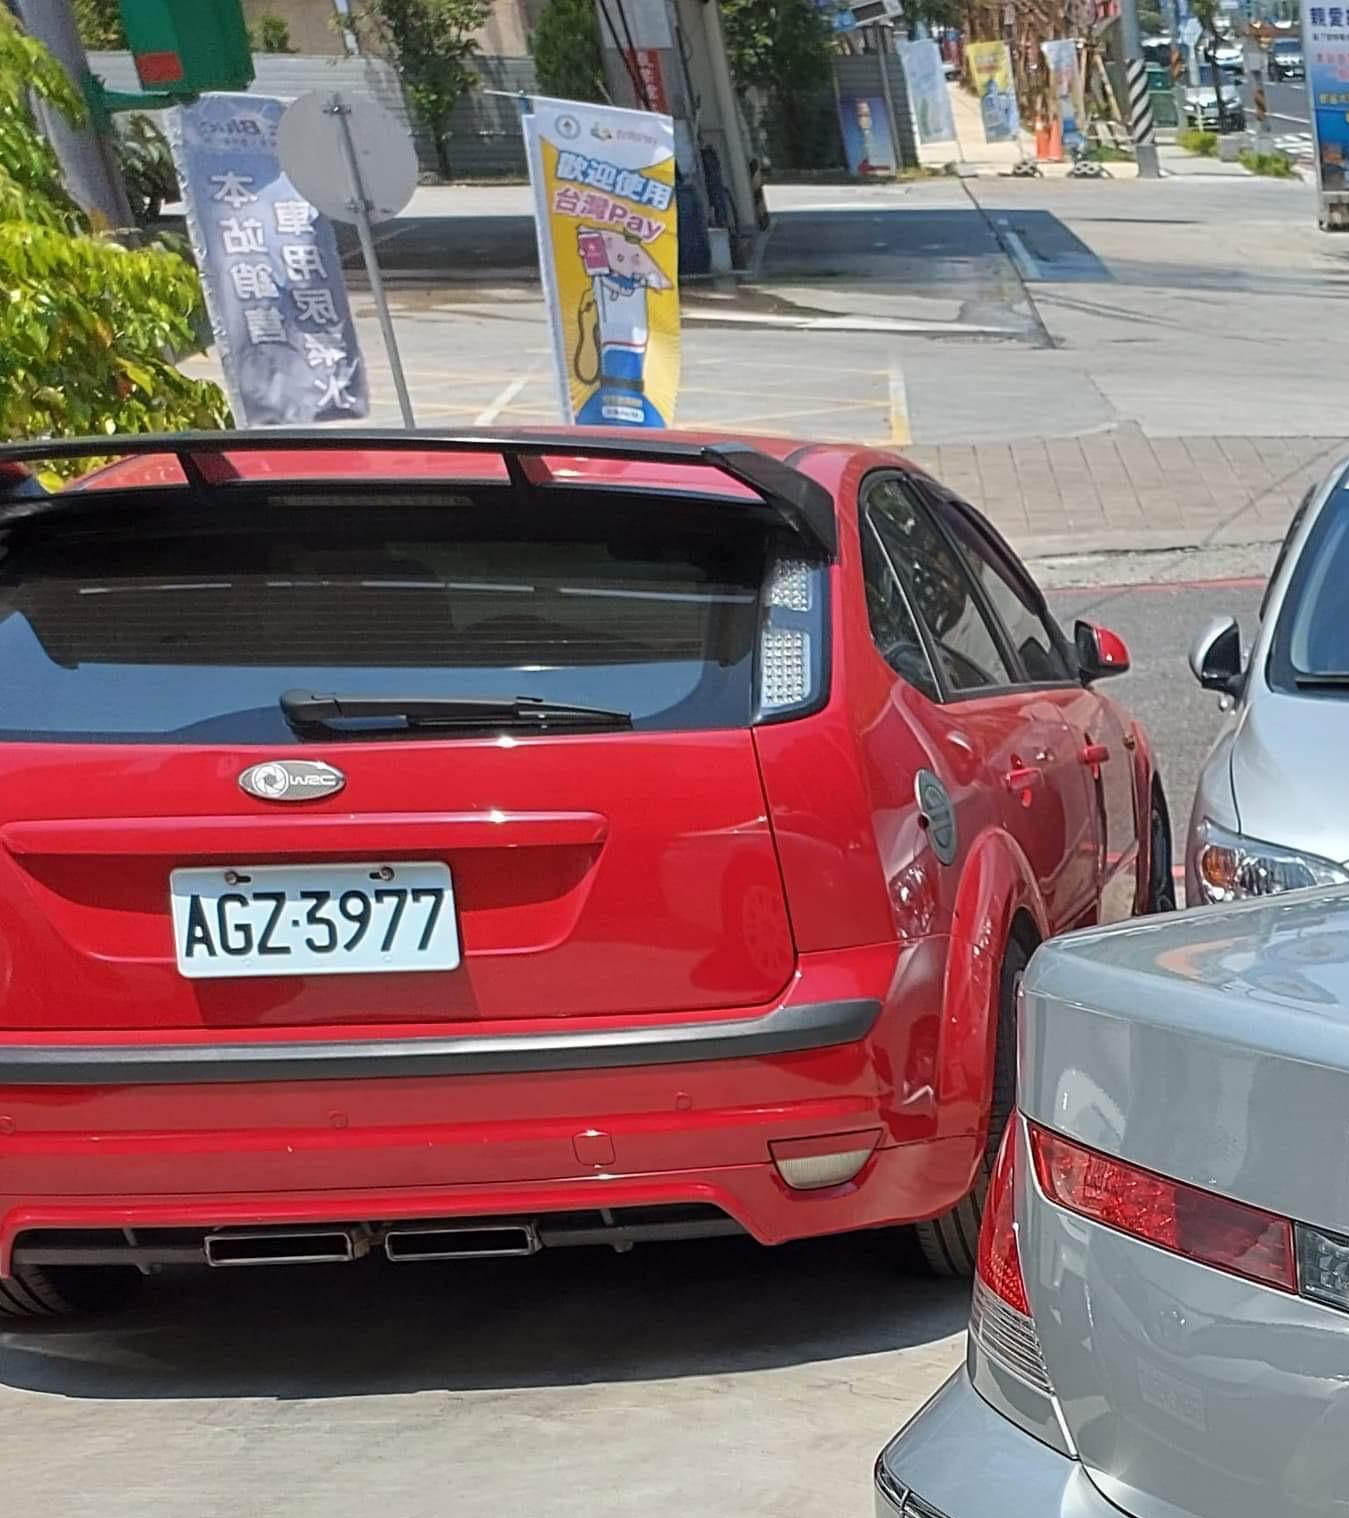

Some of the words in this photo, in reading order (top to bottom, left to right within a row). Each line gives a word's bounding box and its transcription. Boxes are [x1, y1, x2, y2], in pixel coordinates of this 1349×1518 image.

[556, 150, 674, 211] 歡迎使用
[555, 186, 665, 243] 台灣Pay
[289, 774, 337, 785] WRC
